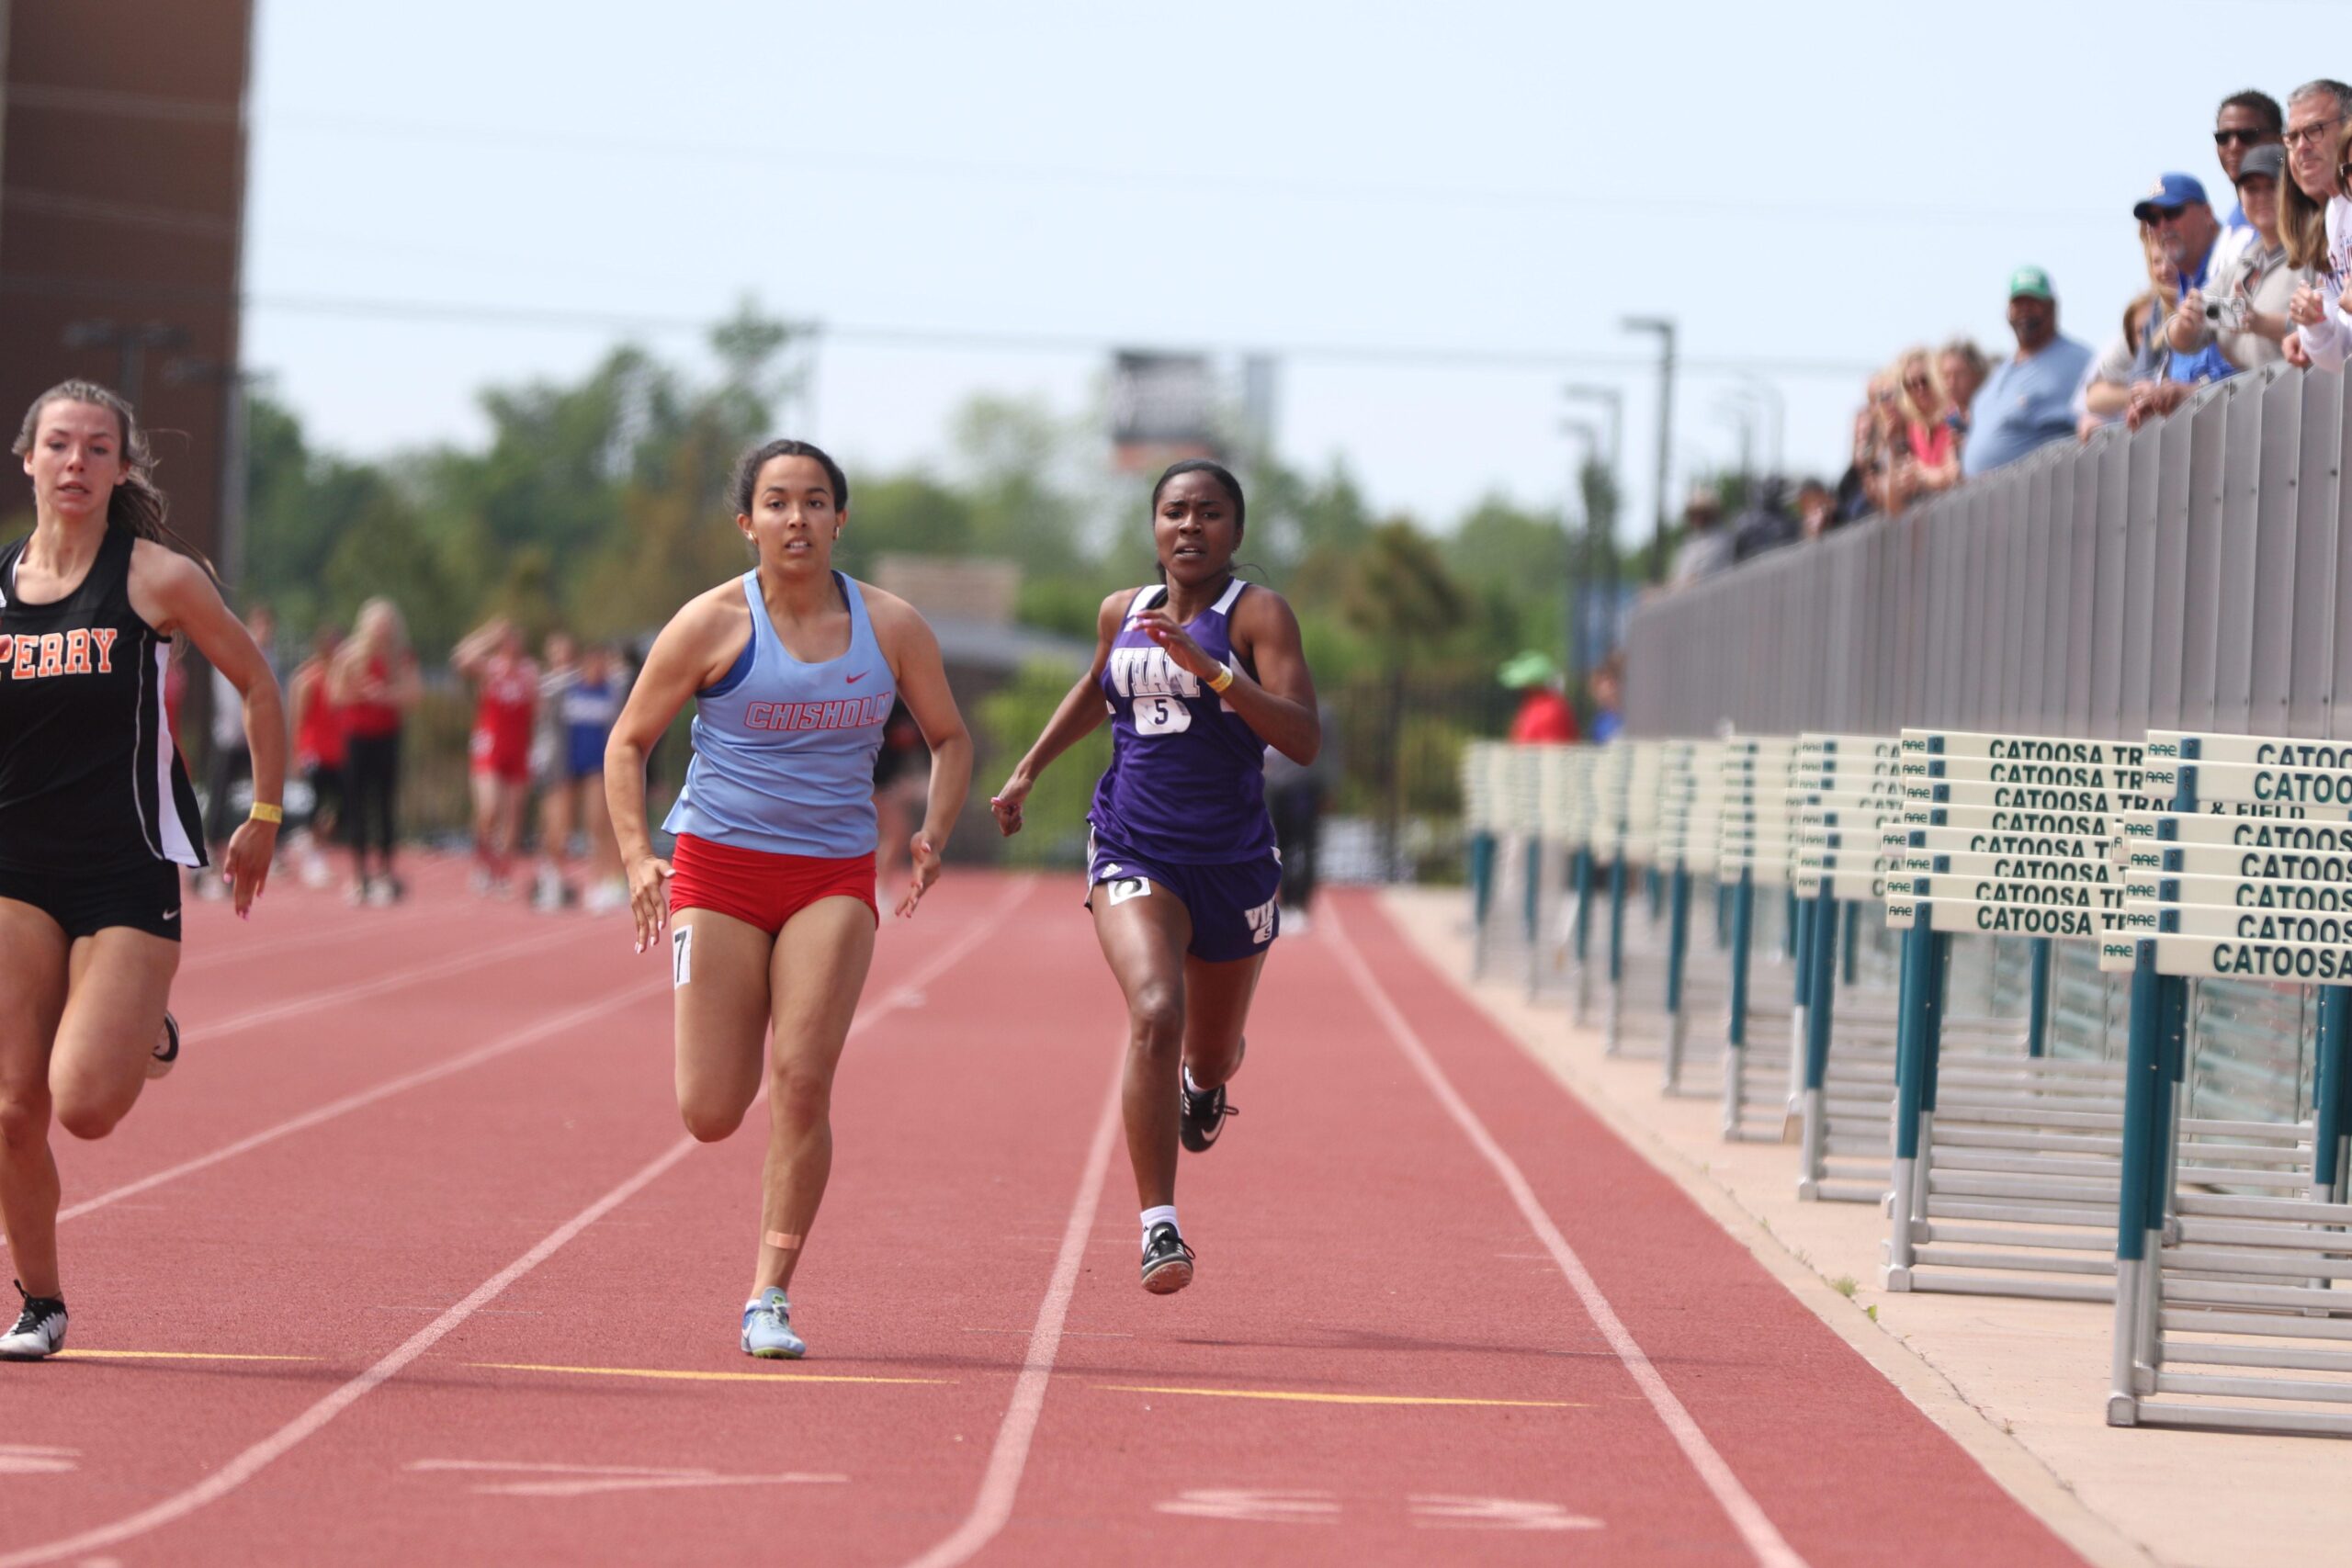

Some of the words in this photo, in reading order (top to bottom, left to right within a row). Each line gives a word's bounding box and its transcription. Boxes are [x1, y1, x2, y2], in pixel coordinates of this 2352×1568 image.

[1154, 699, 1169, 725] 5
[1990, 739, 2103, 764] CATOOSA
[1990, 763, 2104, 788] CATOOSA
[1996, 787, 2109, 813] CATOOSA
[1992, 812, 2106, 836] CATOOSA
[1971, 835, 2085, 858] CATOOSA
[1995, 859, 2109, 883] CATOOSA
[2242, 854, 2352, 883] CATOO
[1976, 882, 2090, 907] CATOOSA
[1977, 906, 2092, 936] CATOOSA
[674, 930, 687, 984] 7
[2214, 943, 2352, 980] CATOOSA
